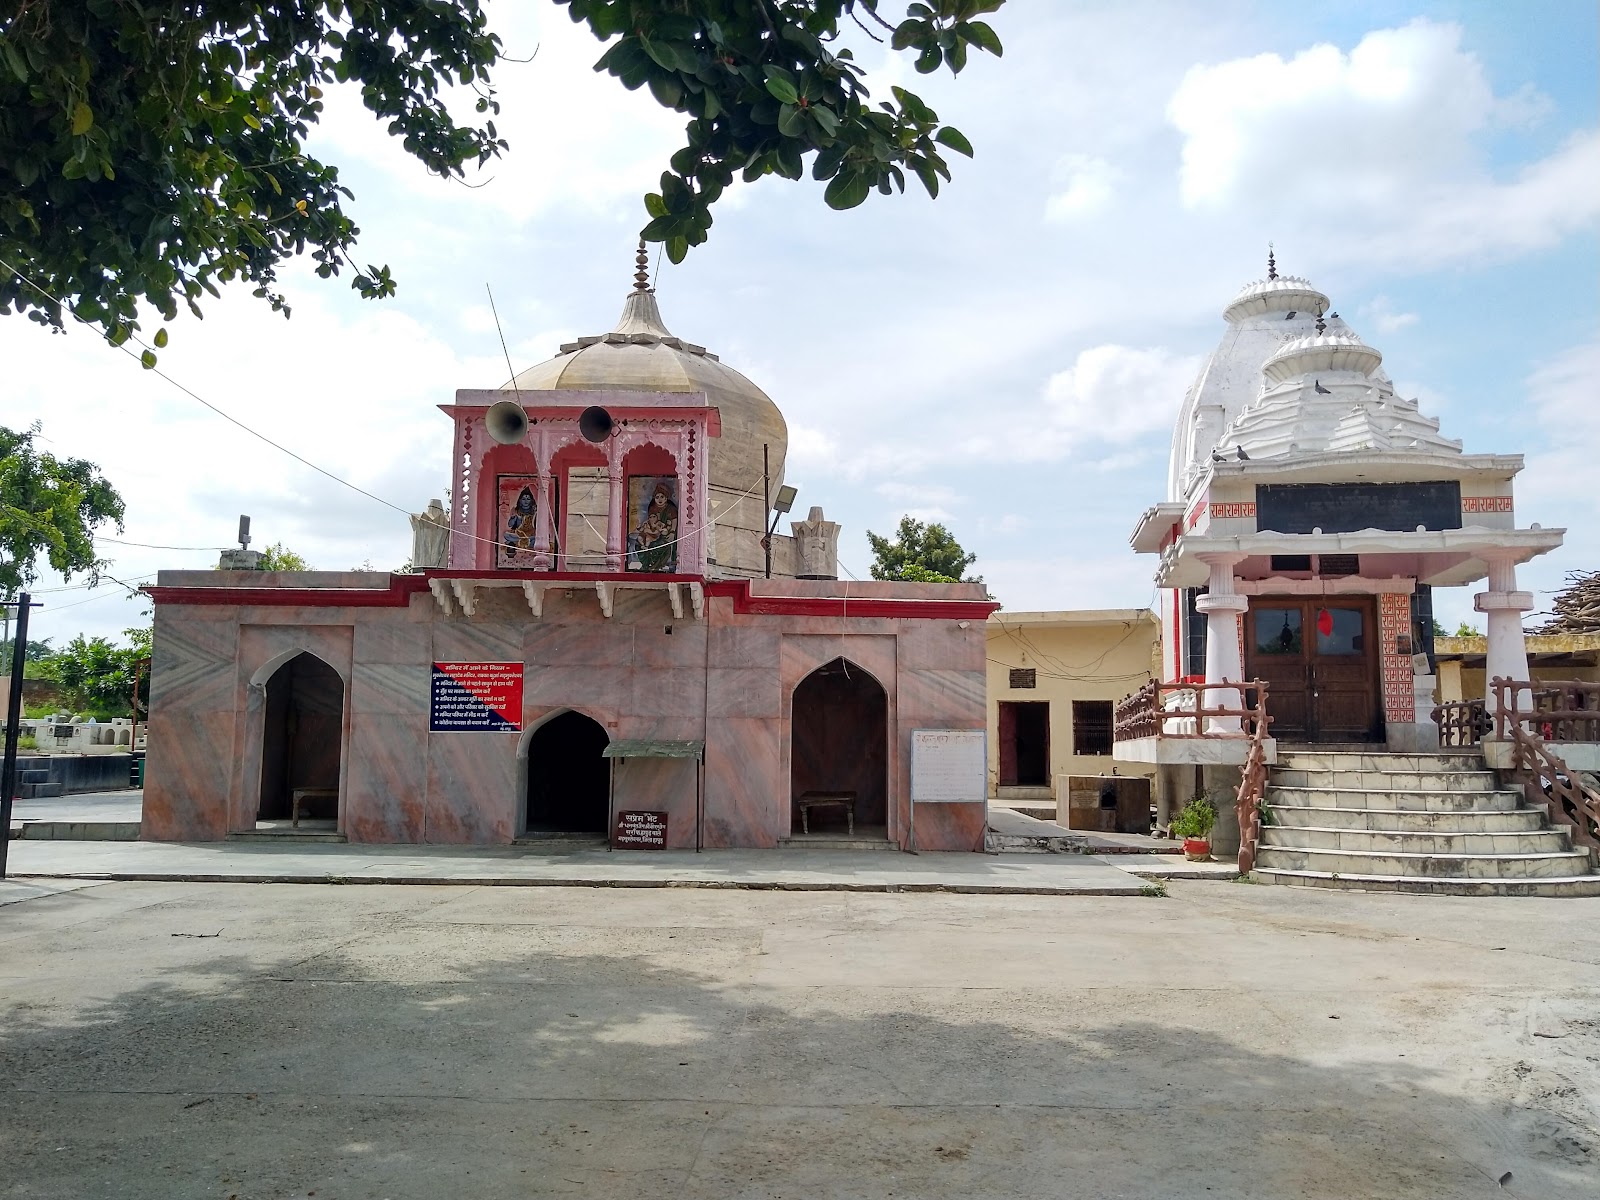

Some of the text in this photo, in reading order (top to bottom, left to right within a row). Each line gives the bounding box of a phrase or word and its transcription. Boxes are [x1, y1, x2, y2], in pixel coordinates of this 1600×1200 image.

[1210, 503, 1256, 518] राम राम राम
[1462, 497, 1512, 512] राम राम राम
[1395, 595, 1409, 607] राम
[1381, 603, 1409, 621] राम राम
[1382, 615, 1410, 634] राम राम
[1383, 628, 1396, 641] राम
[1384, 642, 1396, 654] राम
[1384, 655, 1397, 668] राम
[1399, 655, 1412, 668] राम
[1385, 669, 1412, 681] राम राम
[1385, 682, 1413, 695] राम राम
[1386, 696, 1413, 708] राम राम
[1387, 709, 1414, 722] राम राम
[625, 813, 644, 823] सप्रेम
